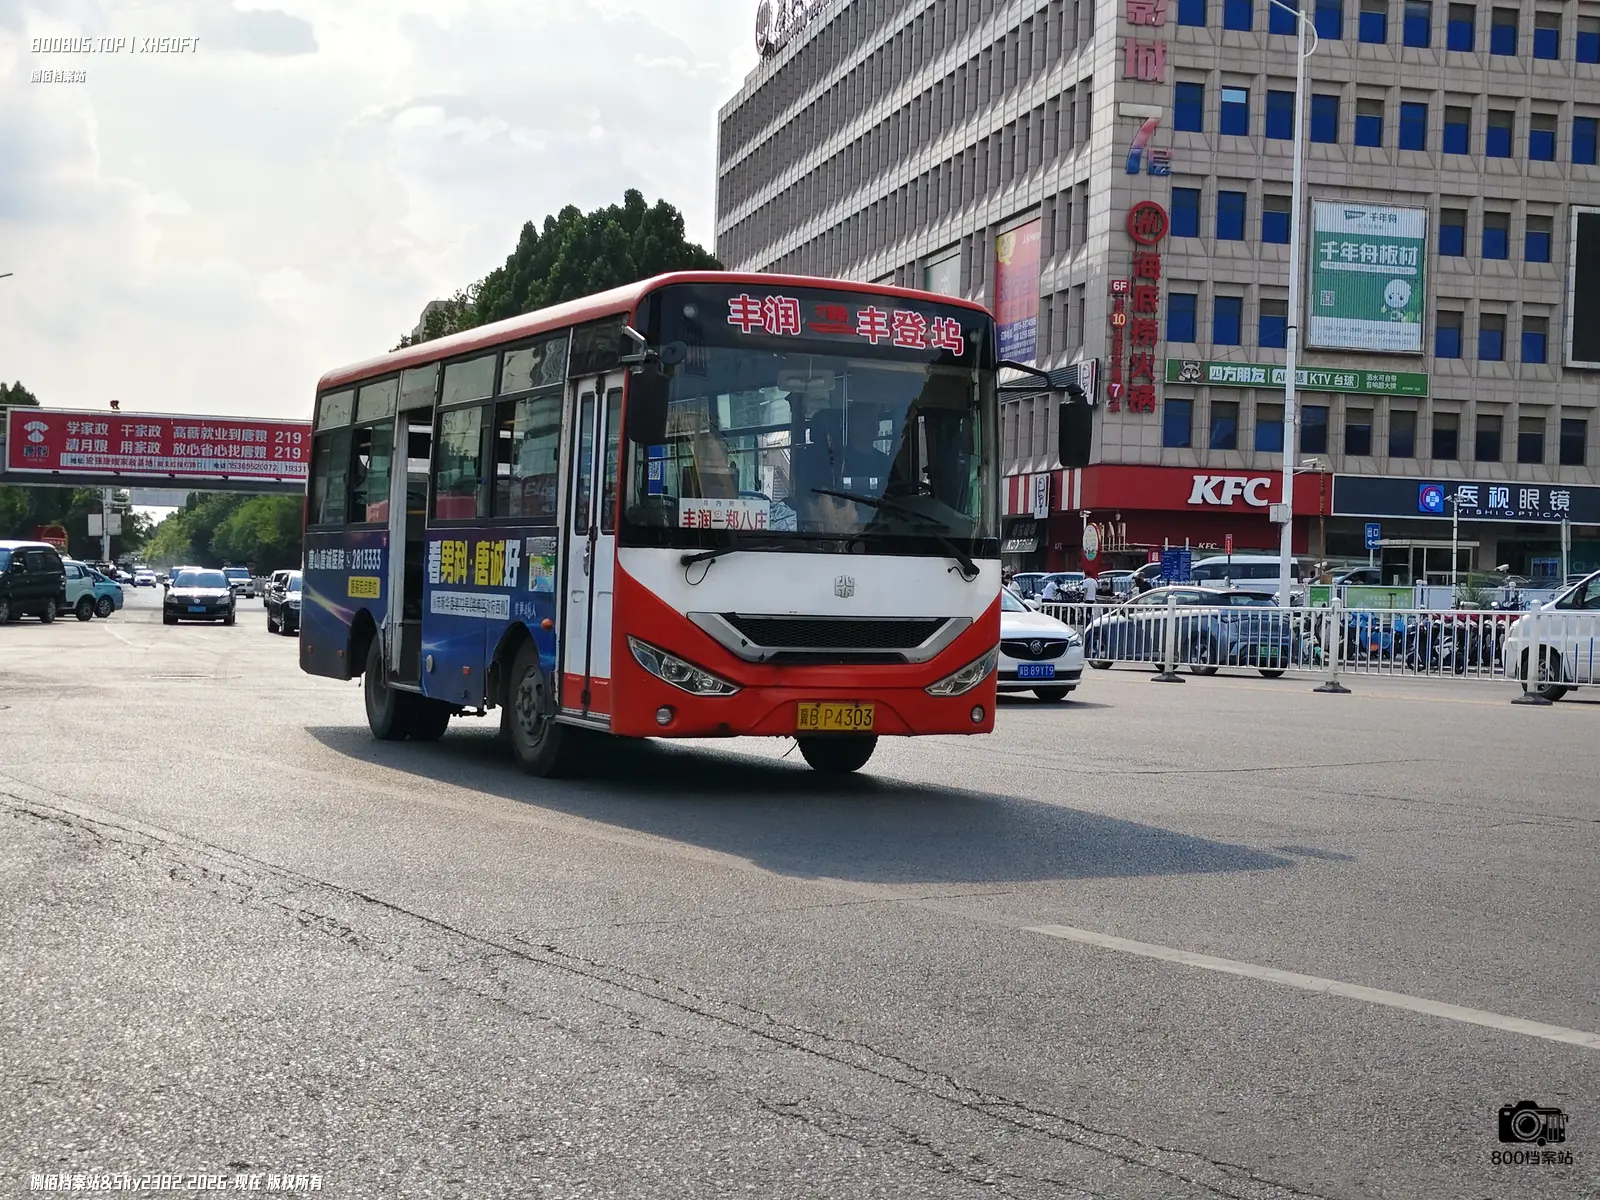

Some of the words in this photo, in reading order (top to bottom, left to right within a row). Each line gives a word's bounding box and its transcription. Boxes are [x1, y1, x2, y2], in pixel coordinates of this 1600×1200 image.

[1112, 281, 1128, 292] 6F
[727, 293, 802, 336] 丰润
[856, 305, 964, 357] 丰登坞
[1112, 313, 1126, 325] 10
[1128, 251, 1161, 415] 海底捞火锅
[1209, 365, 1266, 384] 四方朋友
[1309, 373, 1332, 385] KTV
[66, 421, 109, 436] 学家政
[274, 431, 302, 444] 219
[65, 438, 108, 453] 请月嫂
[120, 440, 162, 455] 用家政
[172, 442, 267, 459] 放心省心找唐嫂
[273, 446, 302, 459] 219
[1187, 475, 1272, 507] KFC
[1458, 485, 1570, 511] 医视眼镜
[1198, 542, 1219, 550] KFC
[351, 548, 381, 570] 2813333
